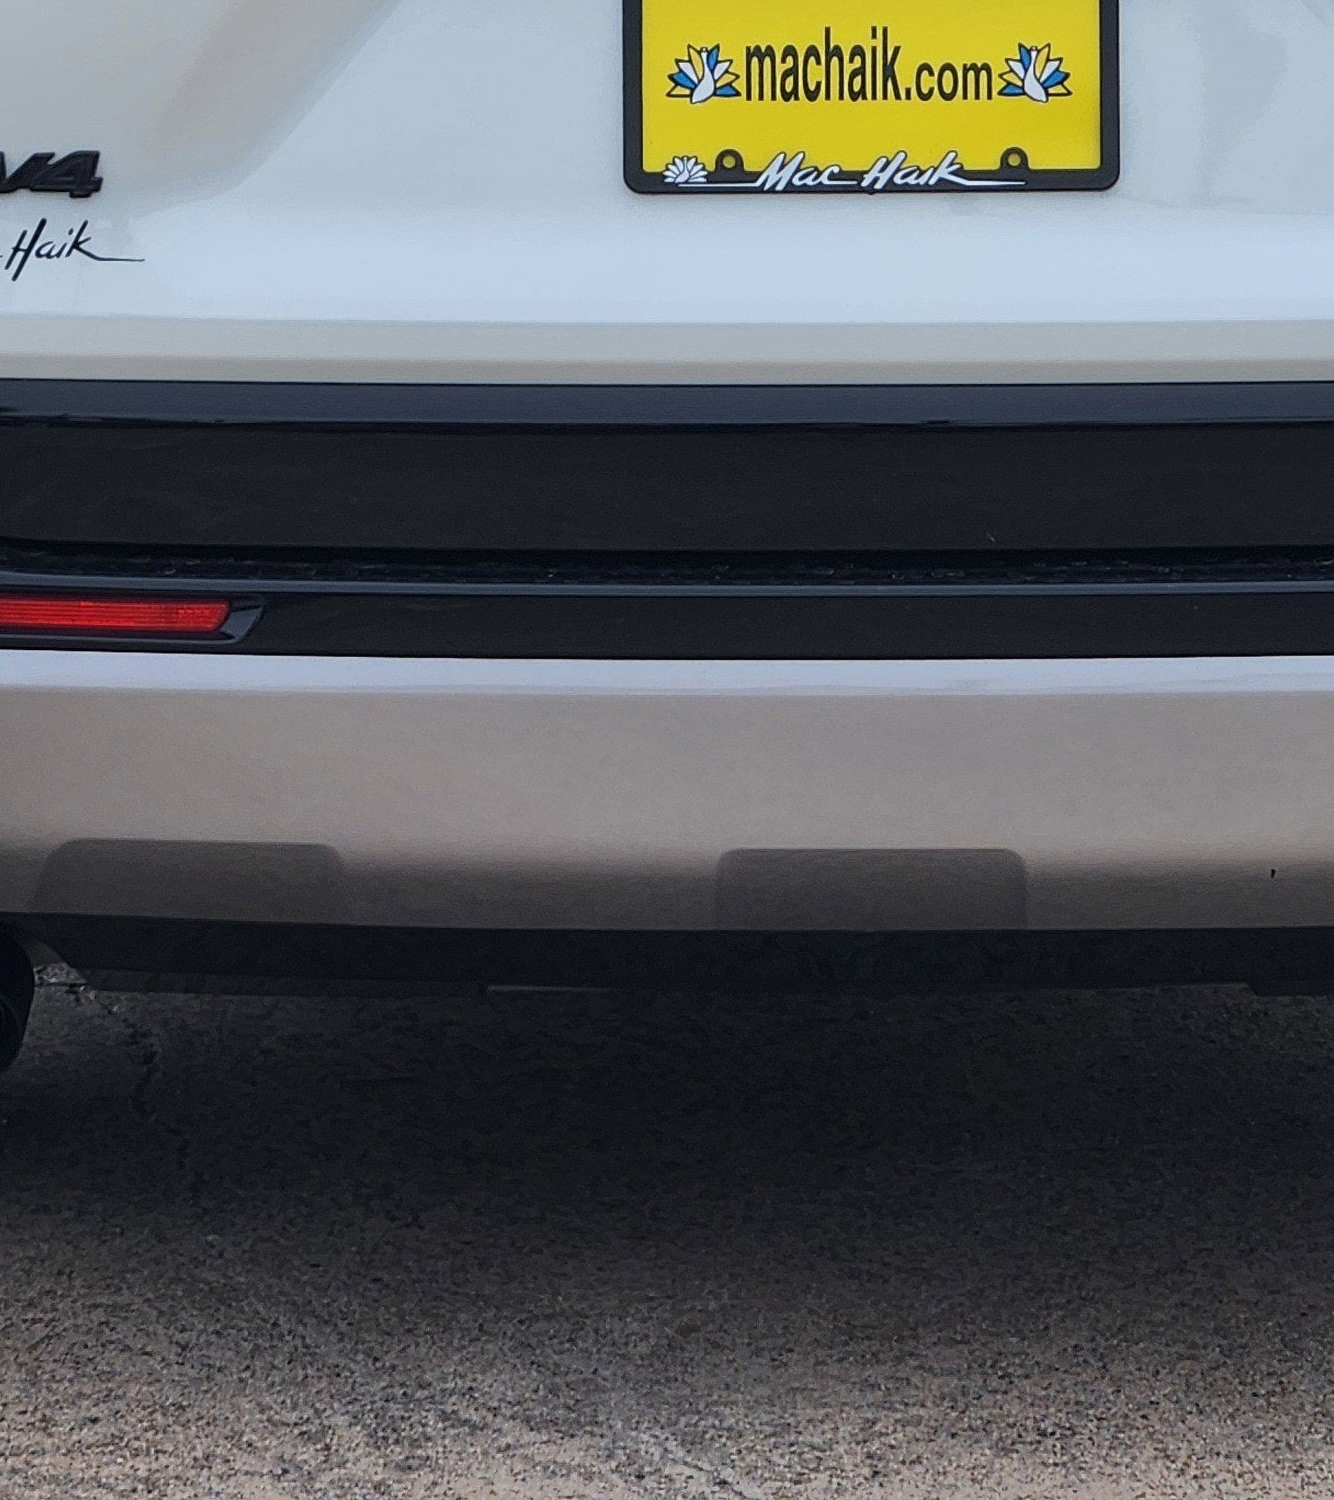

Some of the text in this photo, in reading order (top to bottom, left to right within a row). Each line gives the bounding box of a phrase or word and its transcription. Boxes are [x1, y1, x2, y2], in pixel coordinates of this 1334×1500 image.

[744, 26, 993, 102] machaik.com
[735, 150, 997, 190] Mac Haik
[4, 217, 117, 282] Haik
